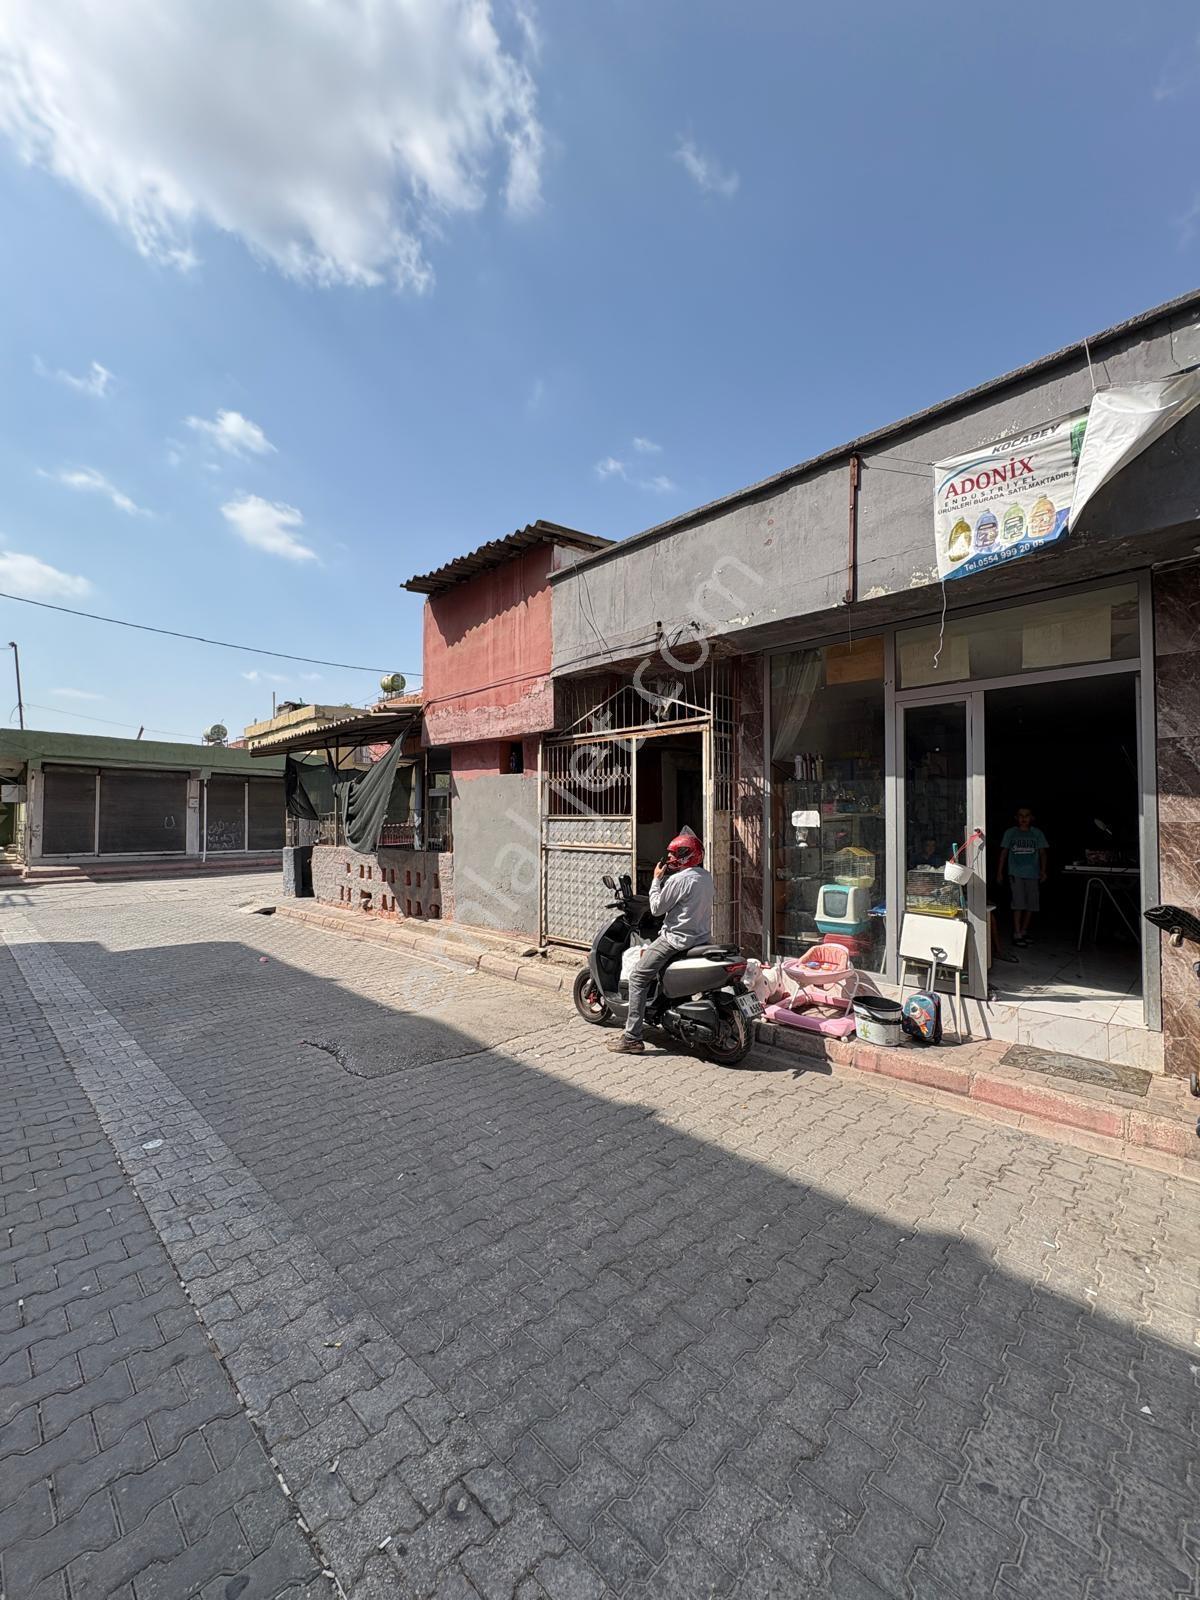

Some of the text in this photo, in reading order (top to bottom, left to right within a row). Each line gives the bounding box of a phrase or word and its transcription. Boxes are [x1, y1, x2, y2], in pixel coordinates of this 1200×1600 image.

[992, 424, 1062, 454] KOCABEY
[944, 456, 1035, 499] ADONİX
[973, 493, 1004, 505] BURADA
[1000, 548, 1017, 560] 999
[1019, 543, 1030, 553] 20
